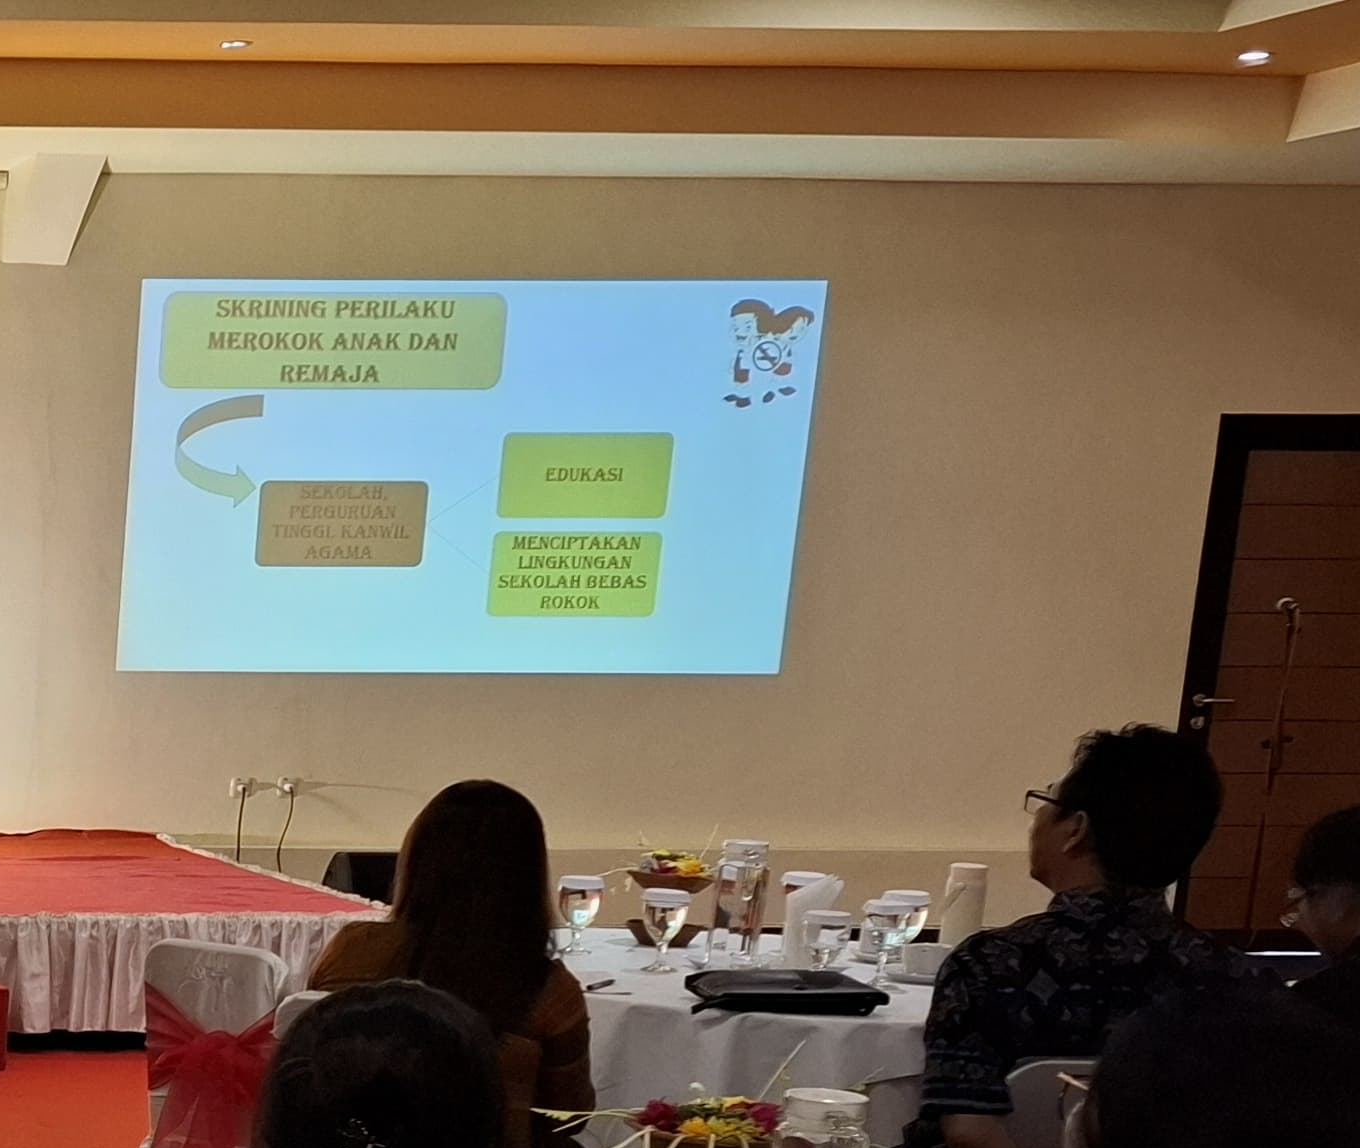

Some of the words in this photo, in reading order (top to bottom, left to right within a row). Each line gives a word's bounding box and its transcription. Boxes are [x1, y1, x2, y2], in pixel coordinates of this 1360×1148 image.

[216, 299, 327, 320] SKRINING
[334, 299, 456, 320] PERILAKU
[207, 331, 325, 352] MEROKOK
[331, 332, 401, 351] ANAK
[408, 332, 459, 351] DAN
[280, 364, 380, 384] REMAJA
[545, 467, 624, 482] EDUKASI
[289, 504, 398, 519] PERGURUAN
[340, 524, 410, 540] KANWIL
[512, 535, 642, 551] MENCIPTAKAN
[304, 545, 373, 560] AGAMA
[518, 555, 633, 570] LINGKUNGAN
[497, 574, 581, 589] SEKOLAH
[586, 574, 648, 589] BEBAS
[540, 595, 601, 610] ROKOK
